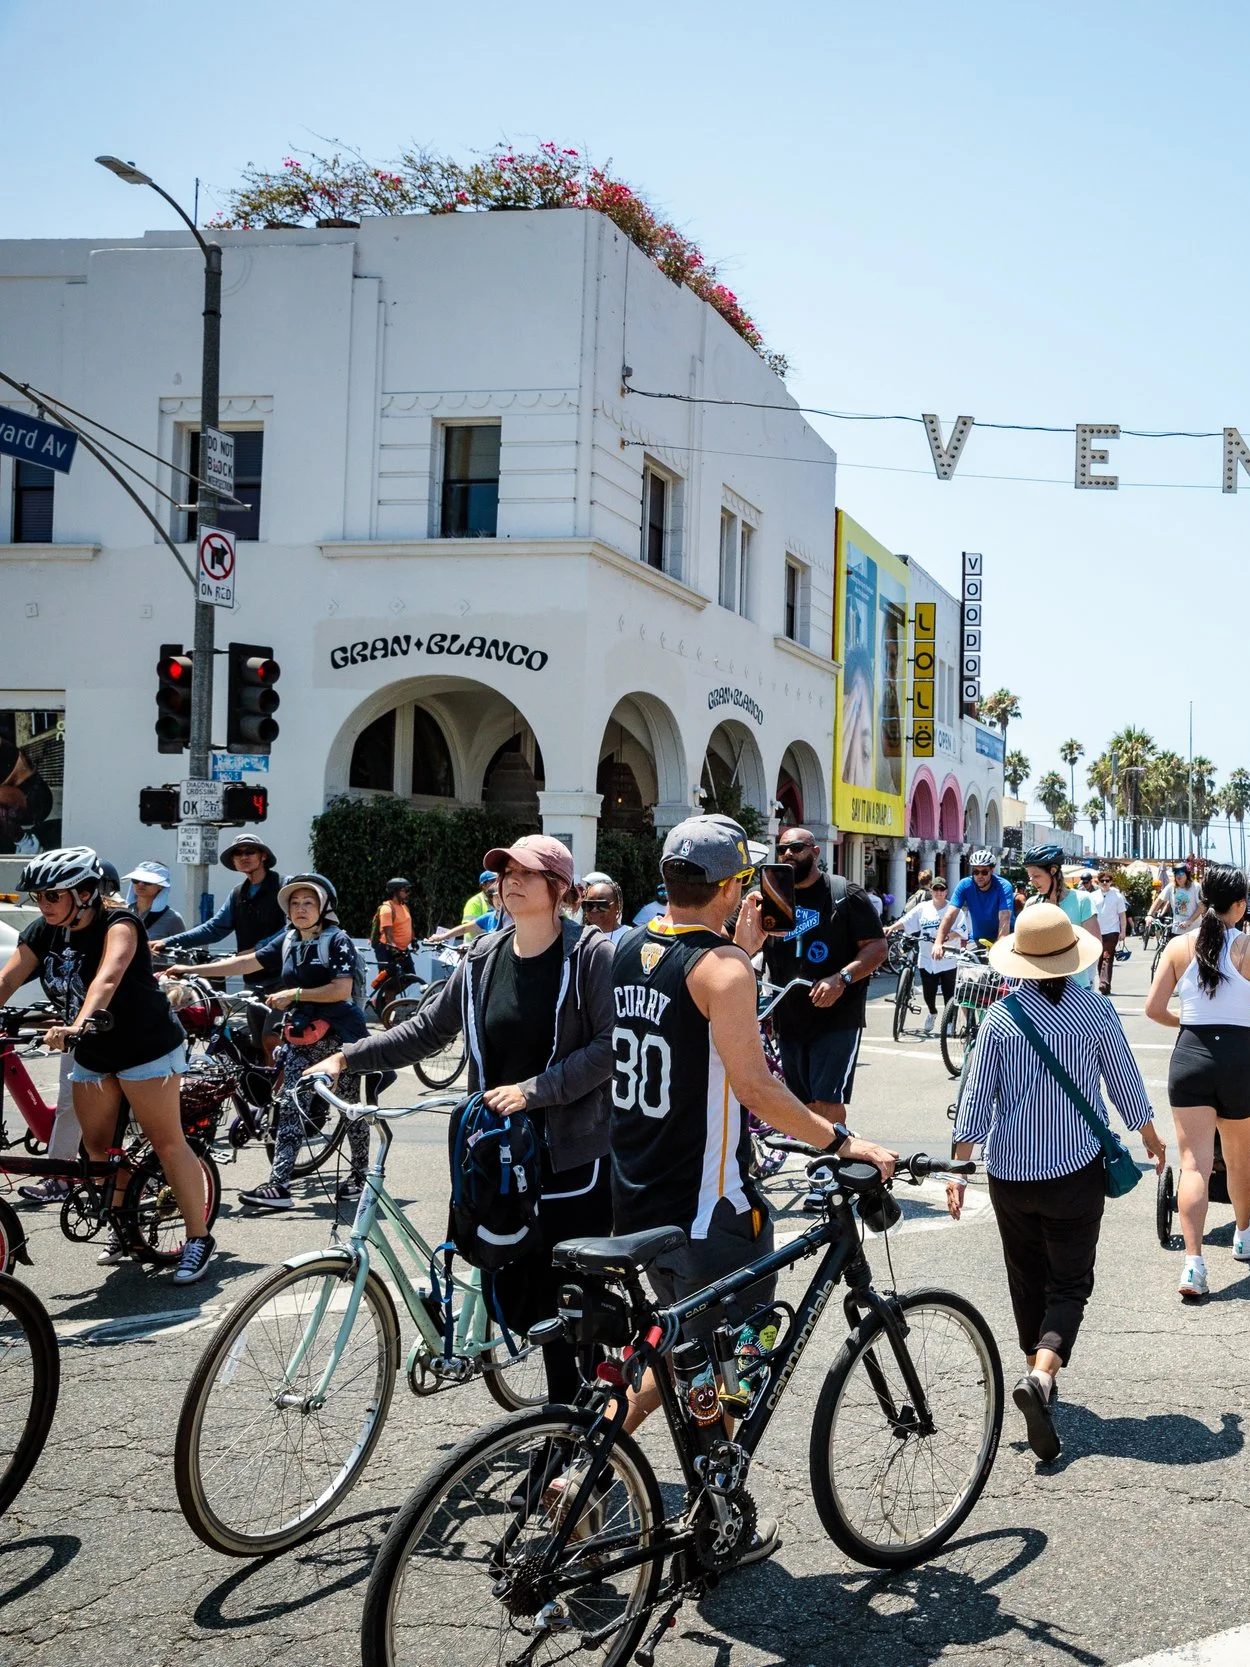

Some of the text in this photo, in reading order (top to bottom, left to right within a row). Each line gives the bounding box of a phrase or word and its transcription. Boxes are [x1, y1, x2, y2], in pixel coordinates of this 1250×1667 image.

[41, 433, 67, 458] Av
[207, 435, 234, 458] DO NOT
[207, 456, 233, 479] BLOCK
[201, 583, 232, 600] ON RED
[965, 557, 980, 698] VOODOO
[330, 633, 549, 671] GRAN BLANCO
[708, 687, 763, 725] GRAN BLANCO
[186, 788, 218, 796] CROSSING
[183, 801, 199, 815] OK
[613, 985, 671, 1026] CURRY
[611, 1026, 672, 1119] 30
[766, 1279, 836, 1411] cannondale
